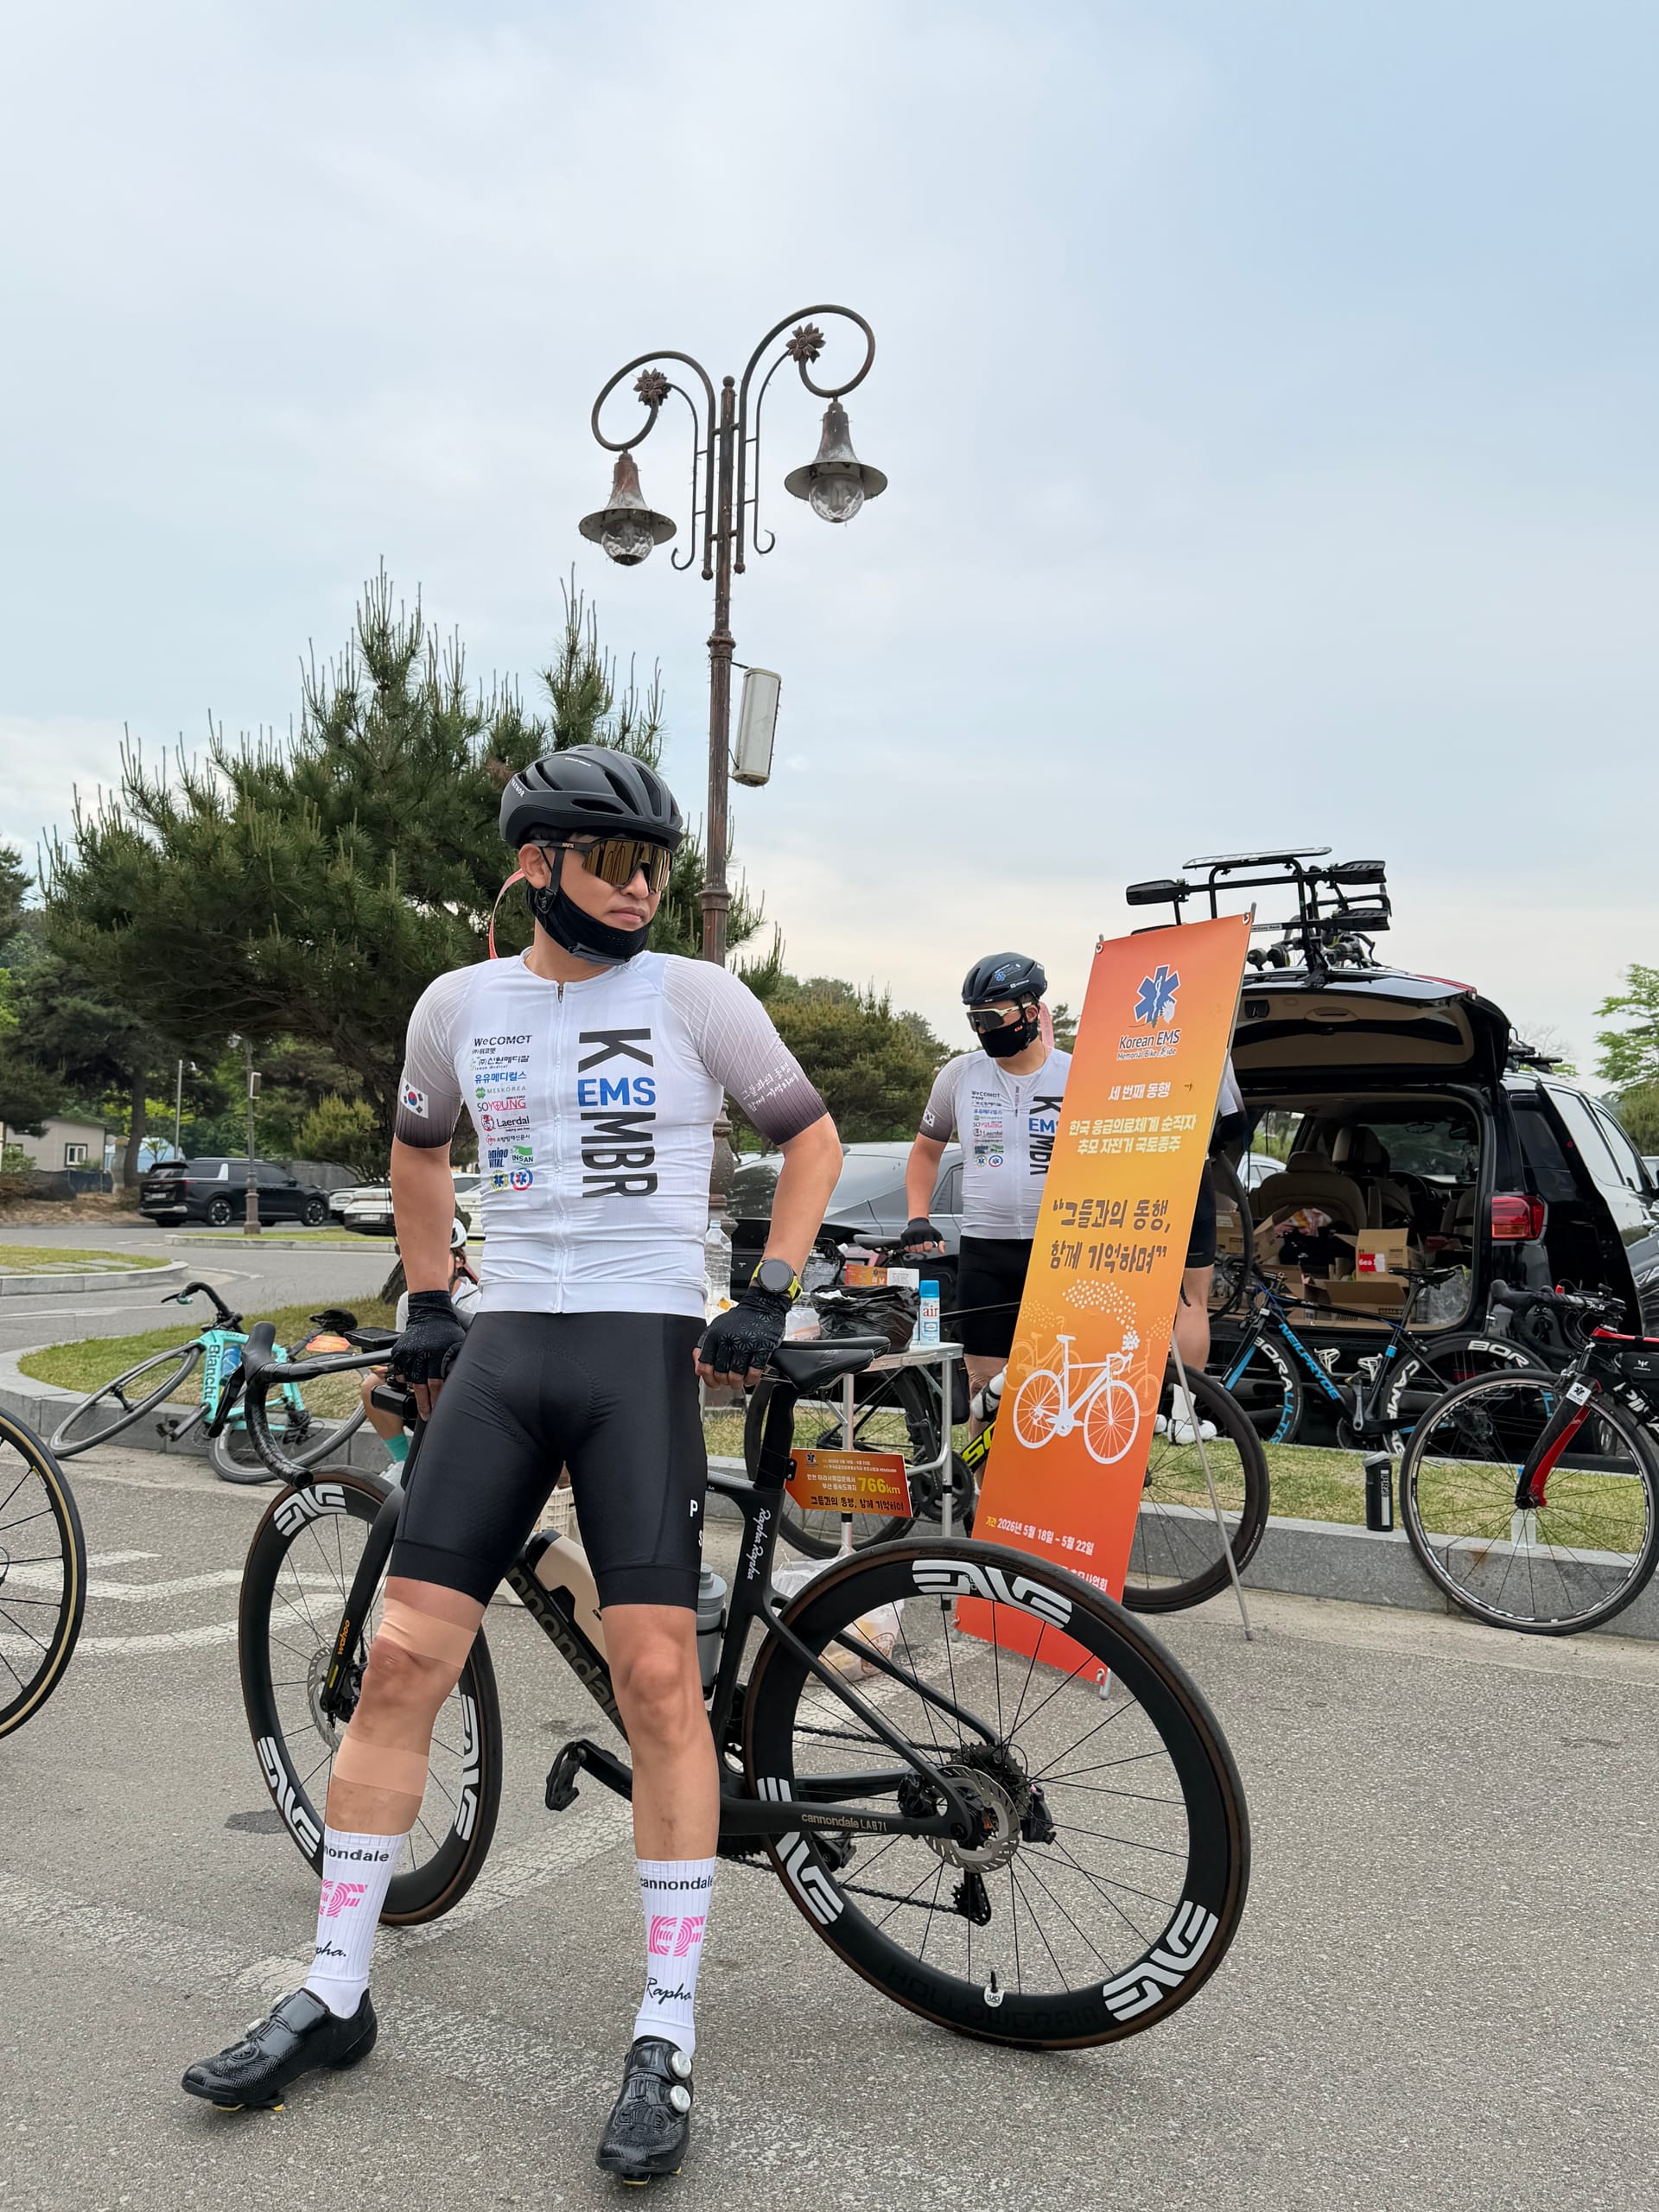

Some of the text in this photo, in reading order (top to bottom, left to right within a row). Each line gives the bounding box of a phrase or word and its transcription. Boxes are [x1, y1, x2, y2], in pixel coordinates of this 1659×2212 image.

[1118, 1029, 1181, 1050] Korean EMS
[1116, 1051, 1143, 1060] Memorial
[474, 1071, 527, 1084] 유유메디컬스
[577, 1077, 657, 1107] EMS
[1108, 1081, 1171, 1101] 세 번째 동행
[496, 1116, 530, 1128] Laerdal
[1028, 1118, 1058, 1134] EM
[1069, 1114, 1197, 1136] 한국 응급의료체계 순직자
[488, 1147, 508, 1159] amino
[1077, 1135, 1181, 1154] 추모 자전거 국토종주
[489, 1158, 505, 1168] VITAL
[512, 1154, 534, 1163] INSAN
[1133, 1199, 1171, 1234] 동행,
[1050, 1239, 1084, 1270] 함께
[923, 1305, 938, 1318] air
[1278, 1323, 1339, 1401] NEILPRYDE
[203, 1344, 221, 1400] Bianchi
[857, 1477, 901, 1495] 766km
[690, 1499, 698, 1517] P
[746, 1508, 772, 1581] Rapha Rapha
[985, 1516, 997, 1528] 기간
[996, 1517, 1024, 1535] 2026년
[1023, 1524, 1036, 1540] 5월
[1037, 1529, 1055, 1545] 18일
[1060, 1535, 1076, 1550] 5월
[1076, 1539, 1096, 1556] 22일
[337, 1618, 351, 1656] wahoo
[801, 1813, 859, 1829] cannondale
[648, 1914, 706, 1957] EF
